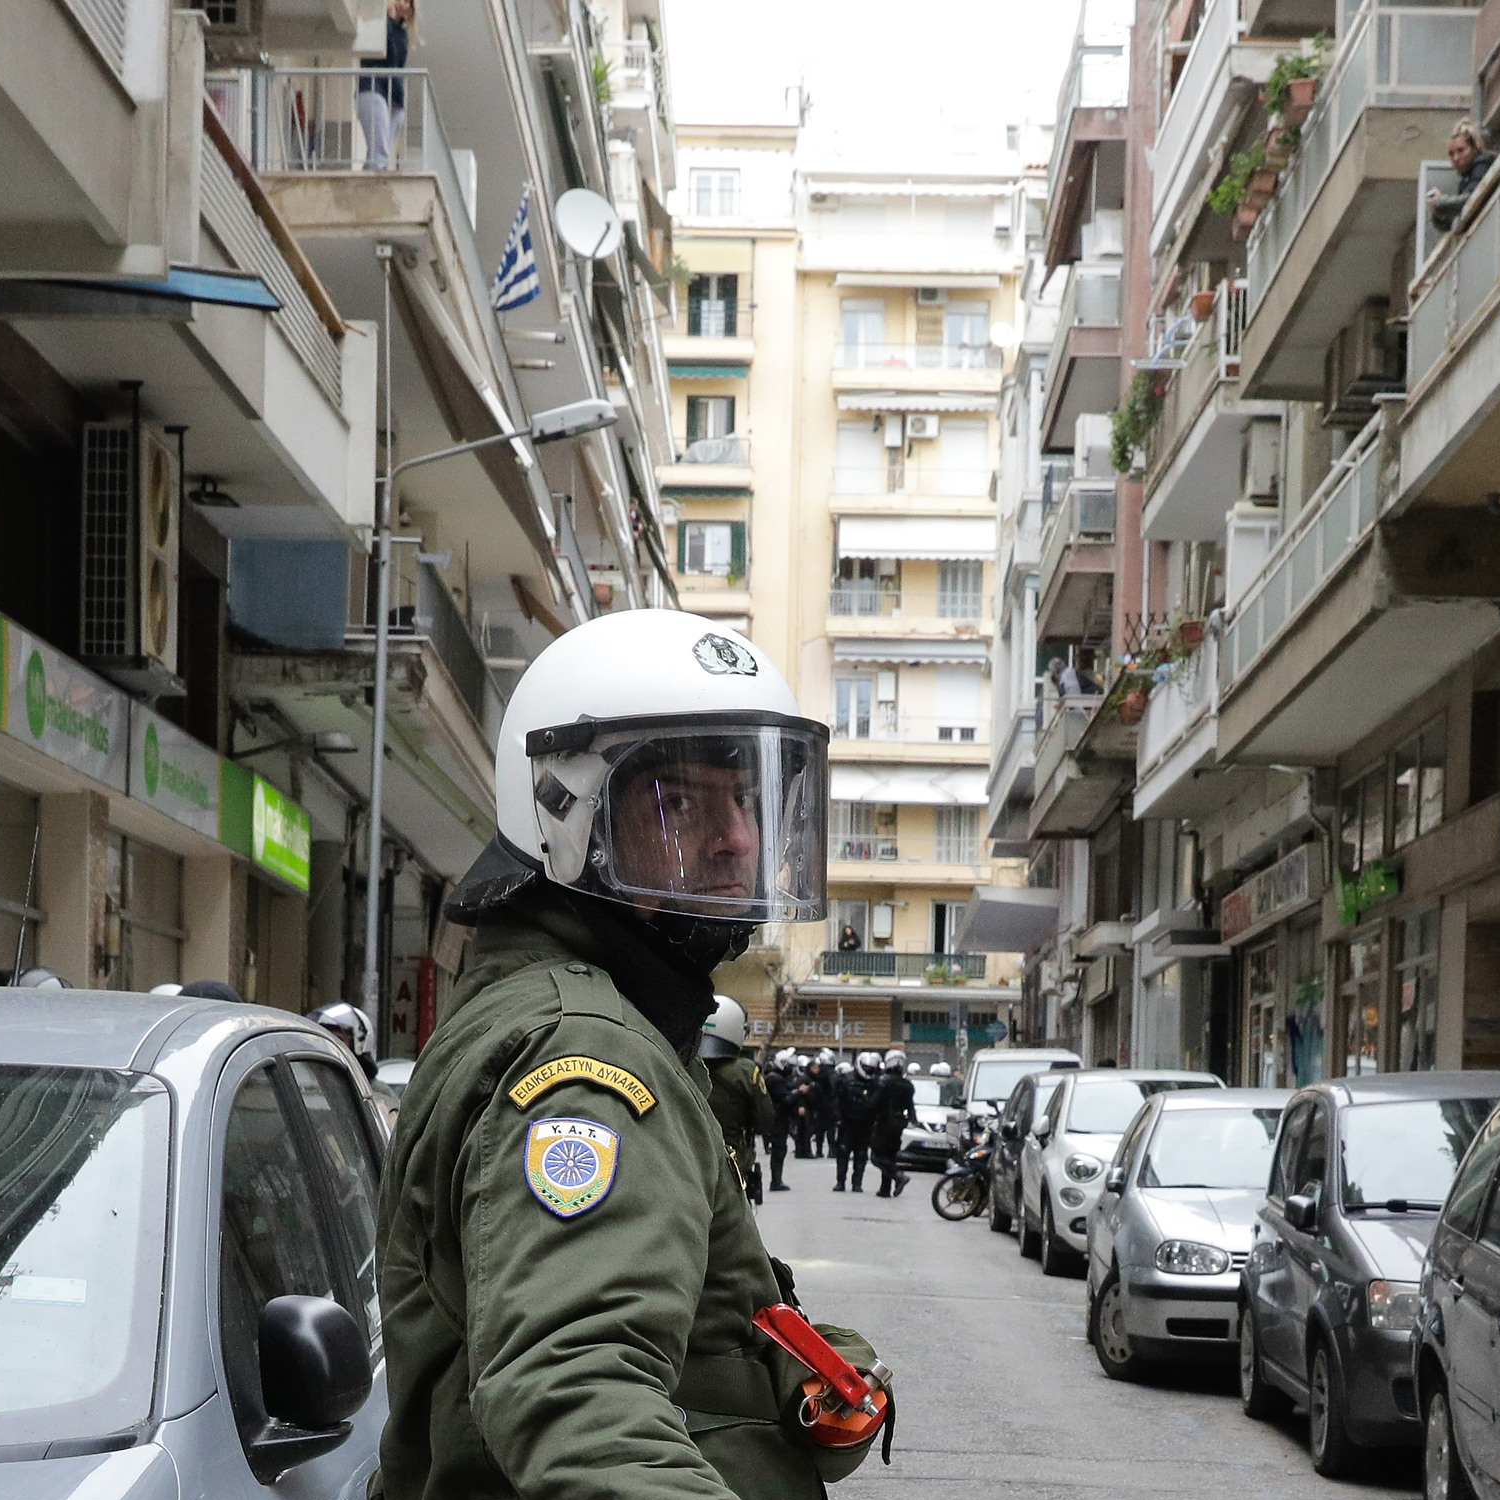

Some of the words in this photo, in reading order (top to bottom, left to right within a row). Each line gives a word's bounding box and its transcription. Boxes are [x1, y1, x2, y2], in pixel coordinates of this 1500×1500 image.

[515, 1066, 557, 1100] ΕΙΔΙΚΕΣ
[556, 1059, 595, 1075] ΑΣΤΥΝ.
[596, 1066, 651, 1107] ΔΥΝΑΜΕΙΣ
